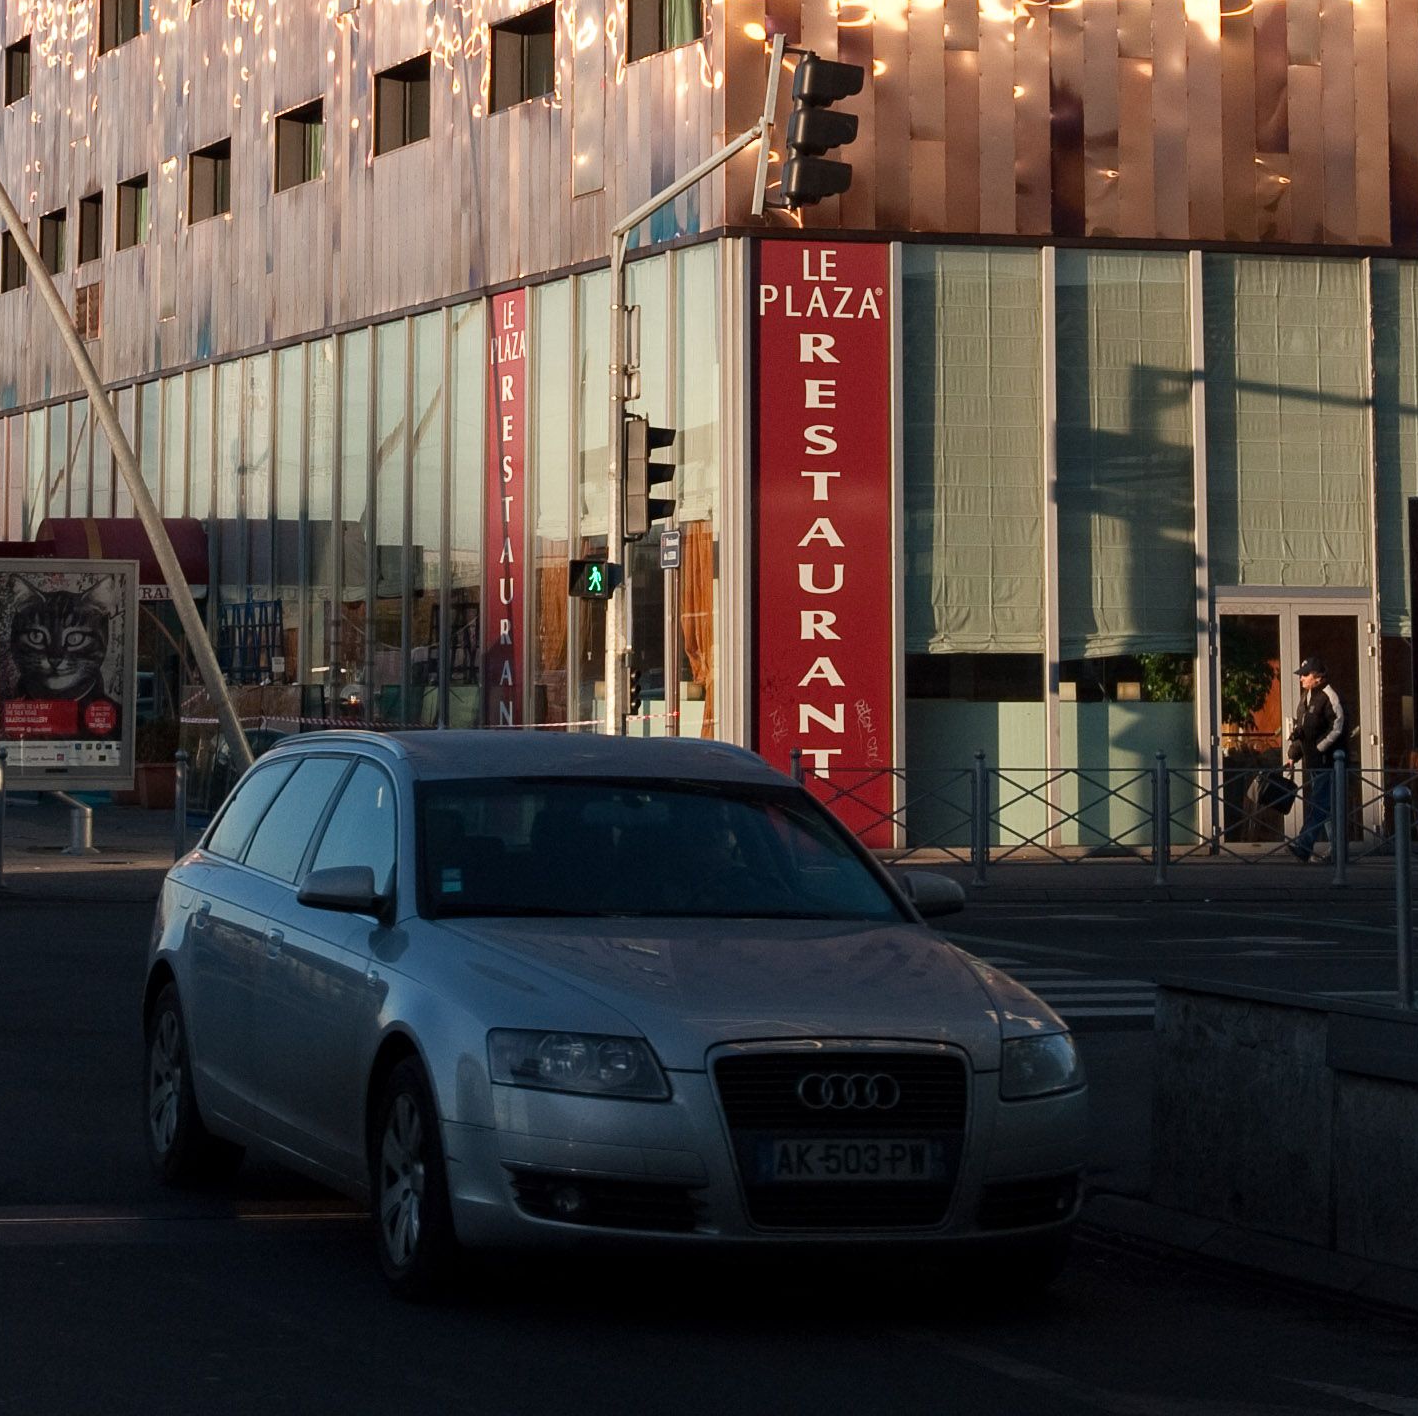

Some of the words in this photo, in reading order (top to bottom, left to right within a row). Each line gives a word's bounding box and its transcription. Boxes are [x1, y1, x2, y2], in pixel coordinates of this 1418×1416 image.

[803, 249, 837, 282] LE
[503, 300, 514, 330] LE
[491, 330, 526, 365] PLAZA
[499, 375, 515, 726] RESTAURAN
[797, 333, 845, 779] RESTAURANT
